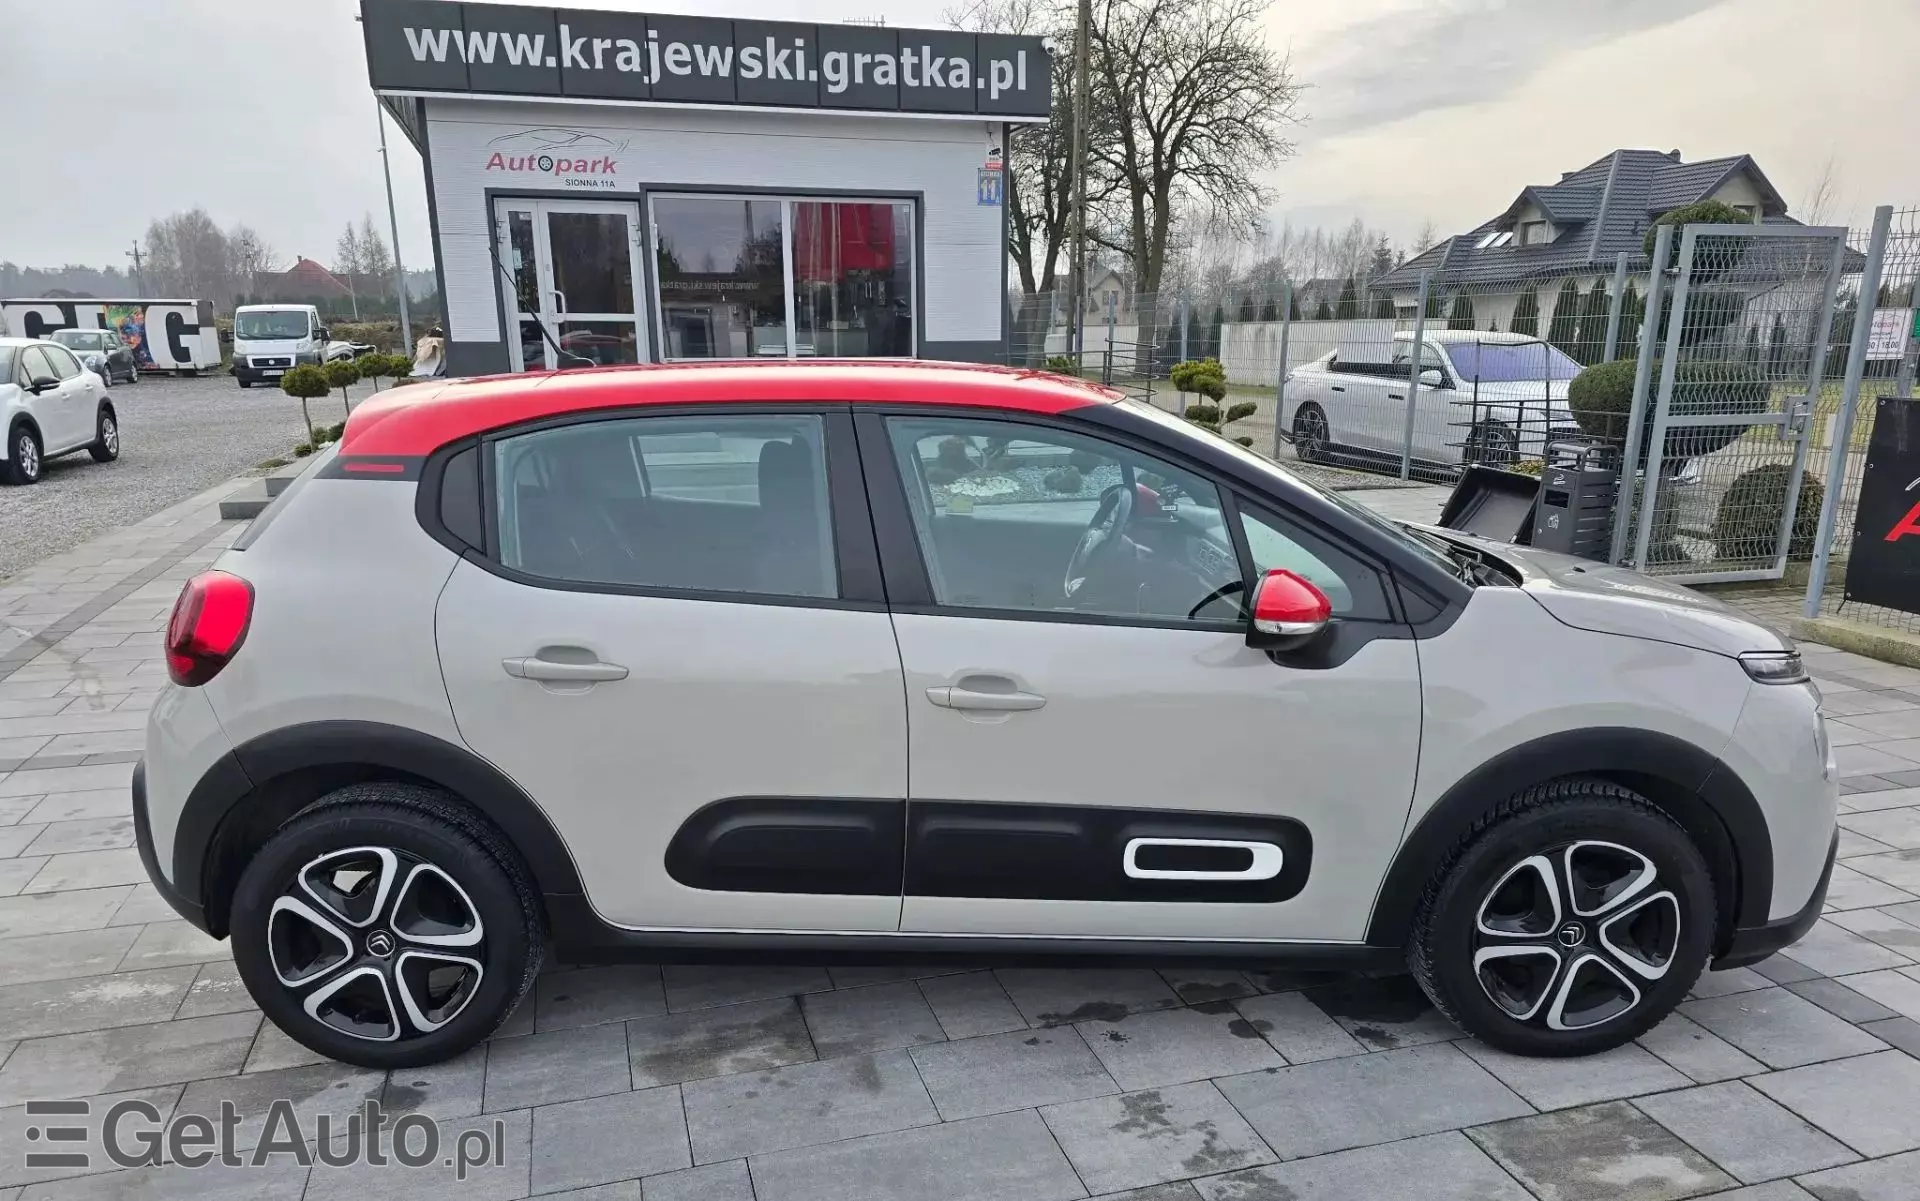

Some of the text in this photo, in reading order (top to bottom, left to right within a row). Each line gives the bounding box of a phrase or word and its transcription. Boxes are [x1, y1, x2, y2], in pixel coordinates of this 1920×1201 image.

[403, 24, 1026, 99] www.krajewski.gratka.pl
[485, 152, 618, 176] Autopark
[565, 179, 615, 188] SIONNA 11A
